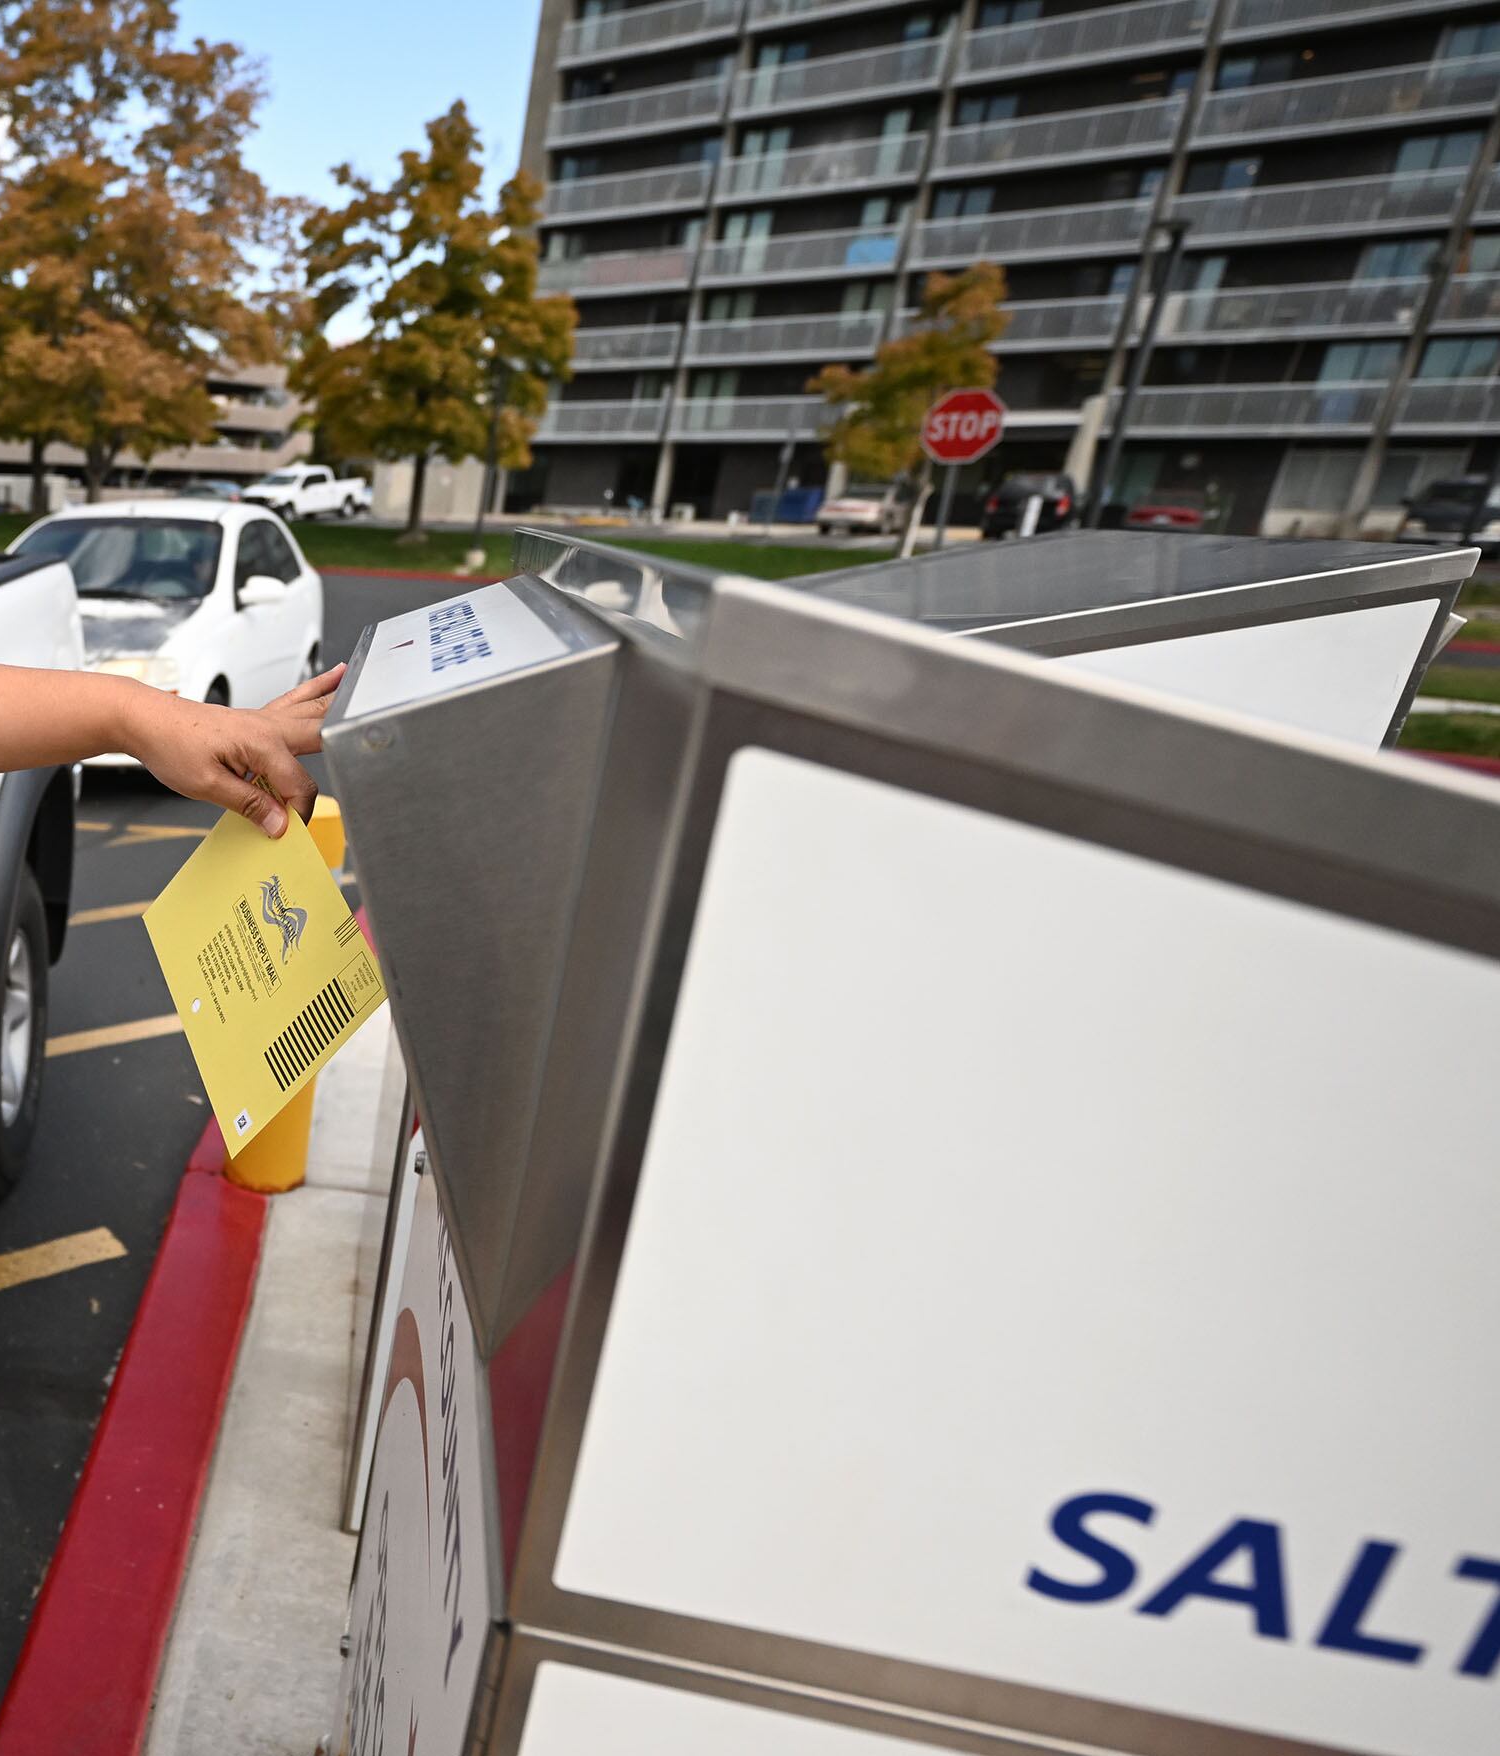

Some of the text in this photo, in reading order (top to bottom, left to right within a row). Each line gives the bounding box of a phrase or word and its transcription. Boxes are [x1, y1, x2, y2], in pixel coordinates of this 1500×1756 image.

[928, 410, 997, 441] STOP
[429, 614, 484, 650] BALLOT
[430, 636, 493, 673] HERE
[268, 885, 288, 921] ELECTION
[283, 920, 297, 943] MAIL
[211, 936, 224, 961] ELECTION
[226, 954, 238, 977] COUNTY
[238, 898, 259, 940] BUSINESS
[254, 936, 270, 967] REPLY
[264, 962, 278, 987] MAIL
[441, 1281, 463, 1689] COUNTY
[1024, 1489, 1500, 1680] SALT
[373, 1490, 389, 1756] OFFIC
